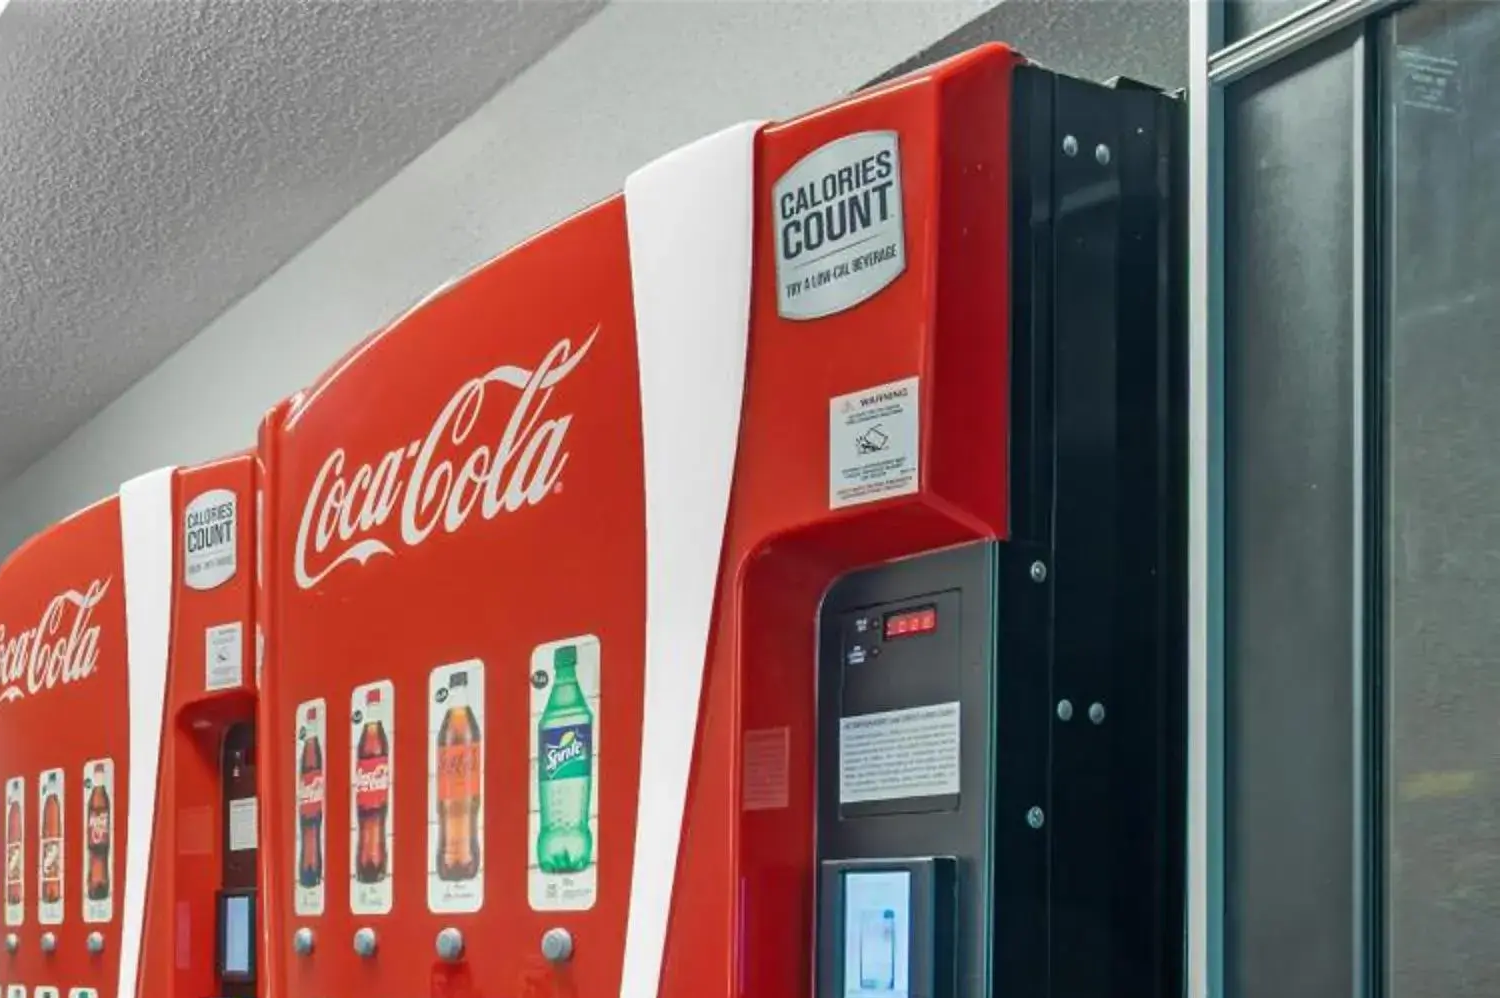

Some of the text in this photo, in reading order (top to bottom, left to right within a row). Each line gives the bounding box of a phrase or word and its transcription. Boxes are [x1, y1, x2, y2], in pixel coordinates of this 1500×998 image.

[781, 150, 892, 220] CALORIES
[783, 181, 893, 260] COUNT
[786, 282, 802, 298] TRY
[851, 243, 897, 272] BEVERAGE
[294, 323, 601, 589] Coca-Cola
[188, 502, 233, 528] CALORIES
[188, 520, 233, 553] COUNT
